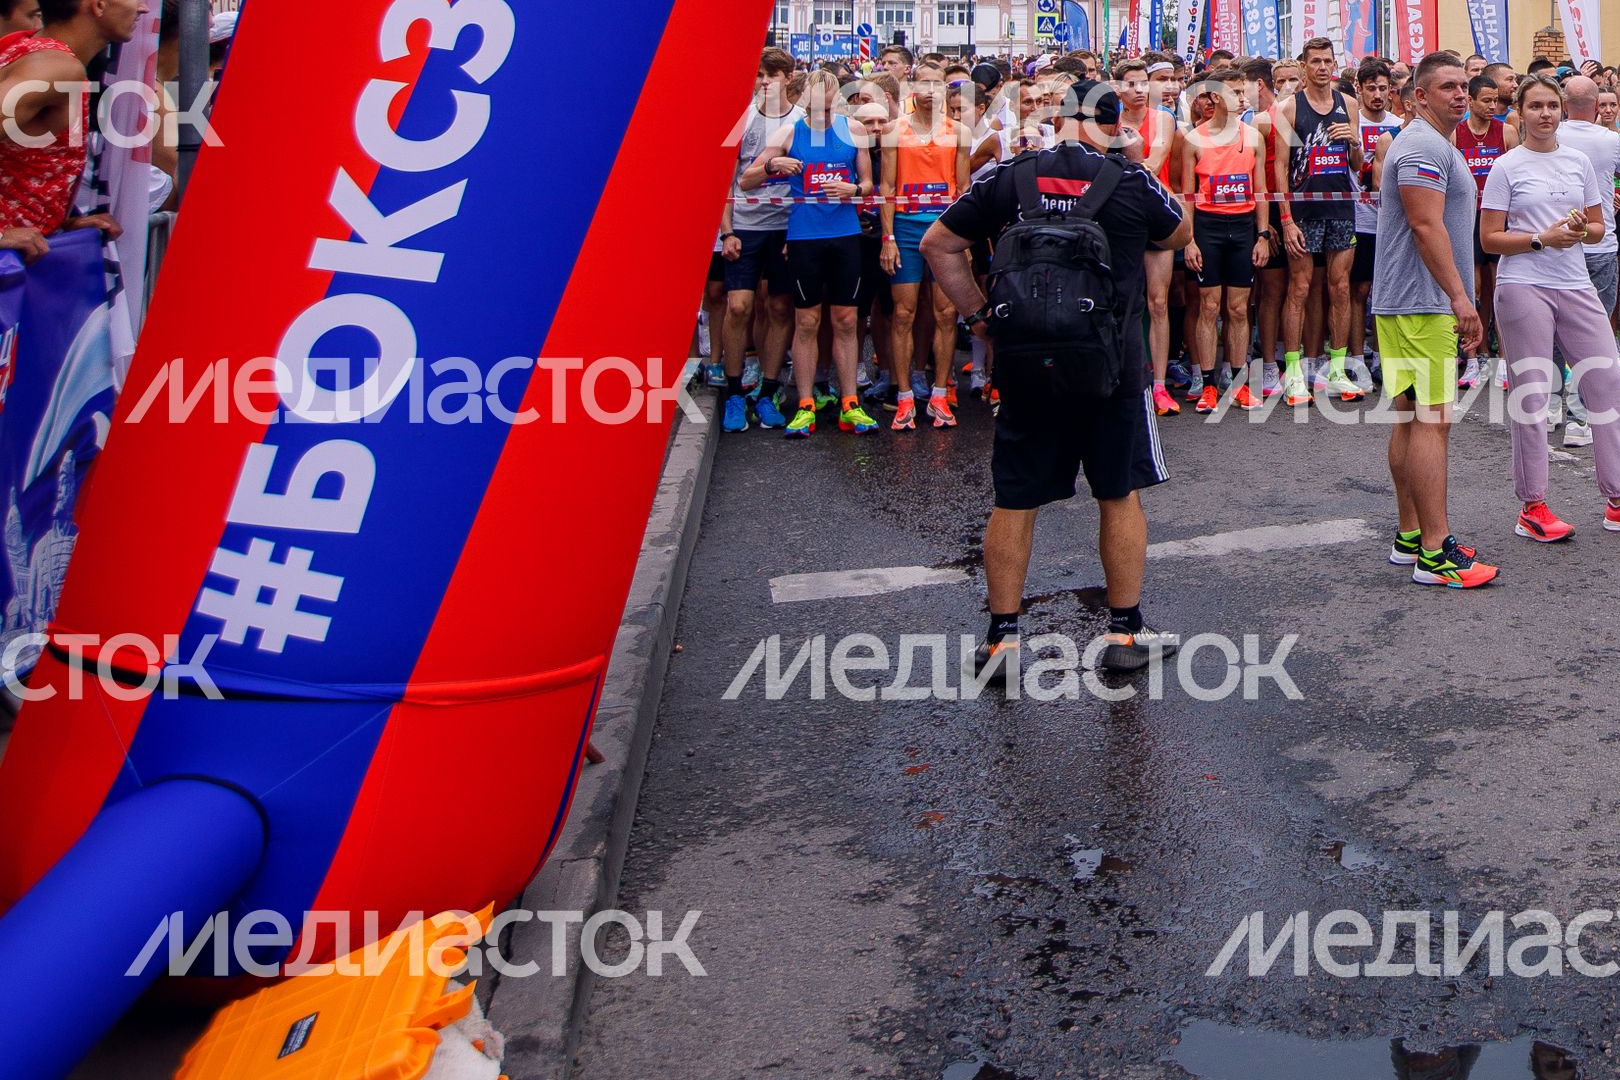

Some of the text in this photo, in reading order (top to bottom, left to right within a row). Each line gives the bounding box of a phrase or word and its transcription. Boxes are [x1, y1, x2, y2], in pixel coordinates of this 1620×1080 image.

[1315, 157, 1340, 166] 5893
[1469, 158, 1494, 167] 5892
[1216, 184, 1245, 195] 5646
